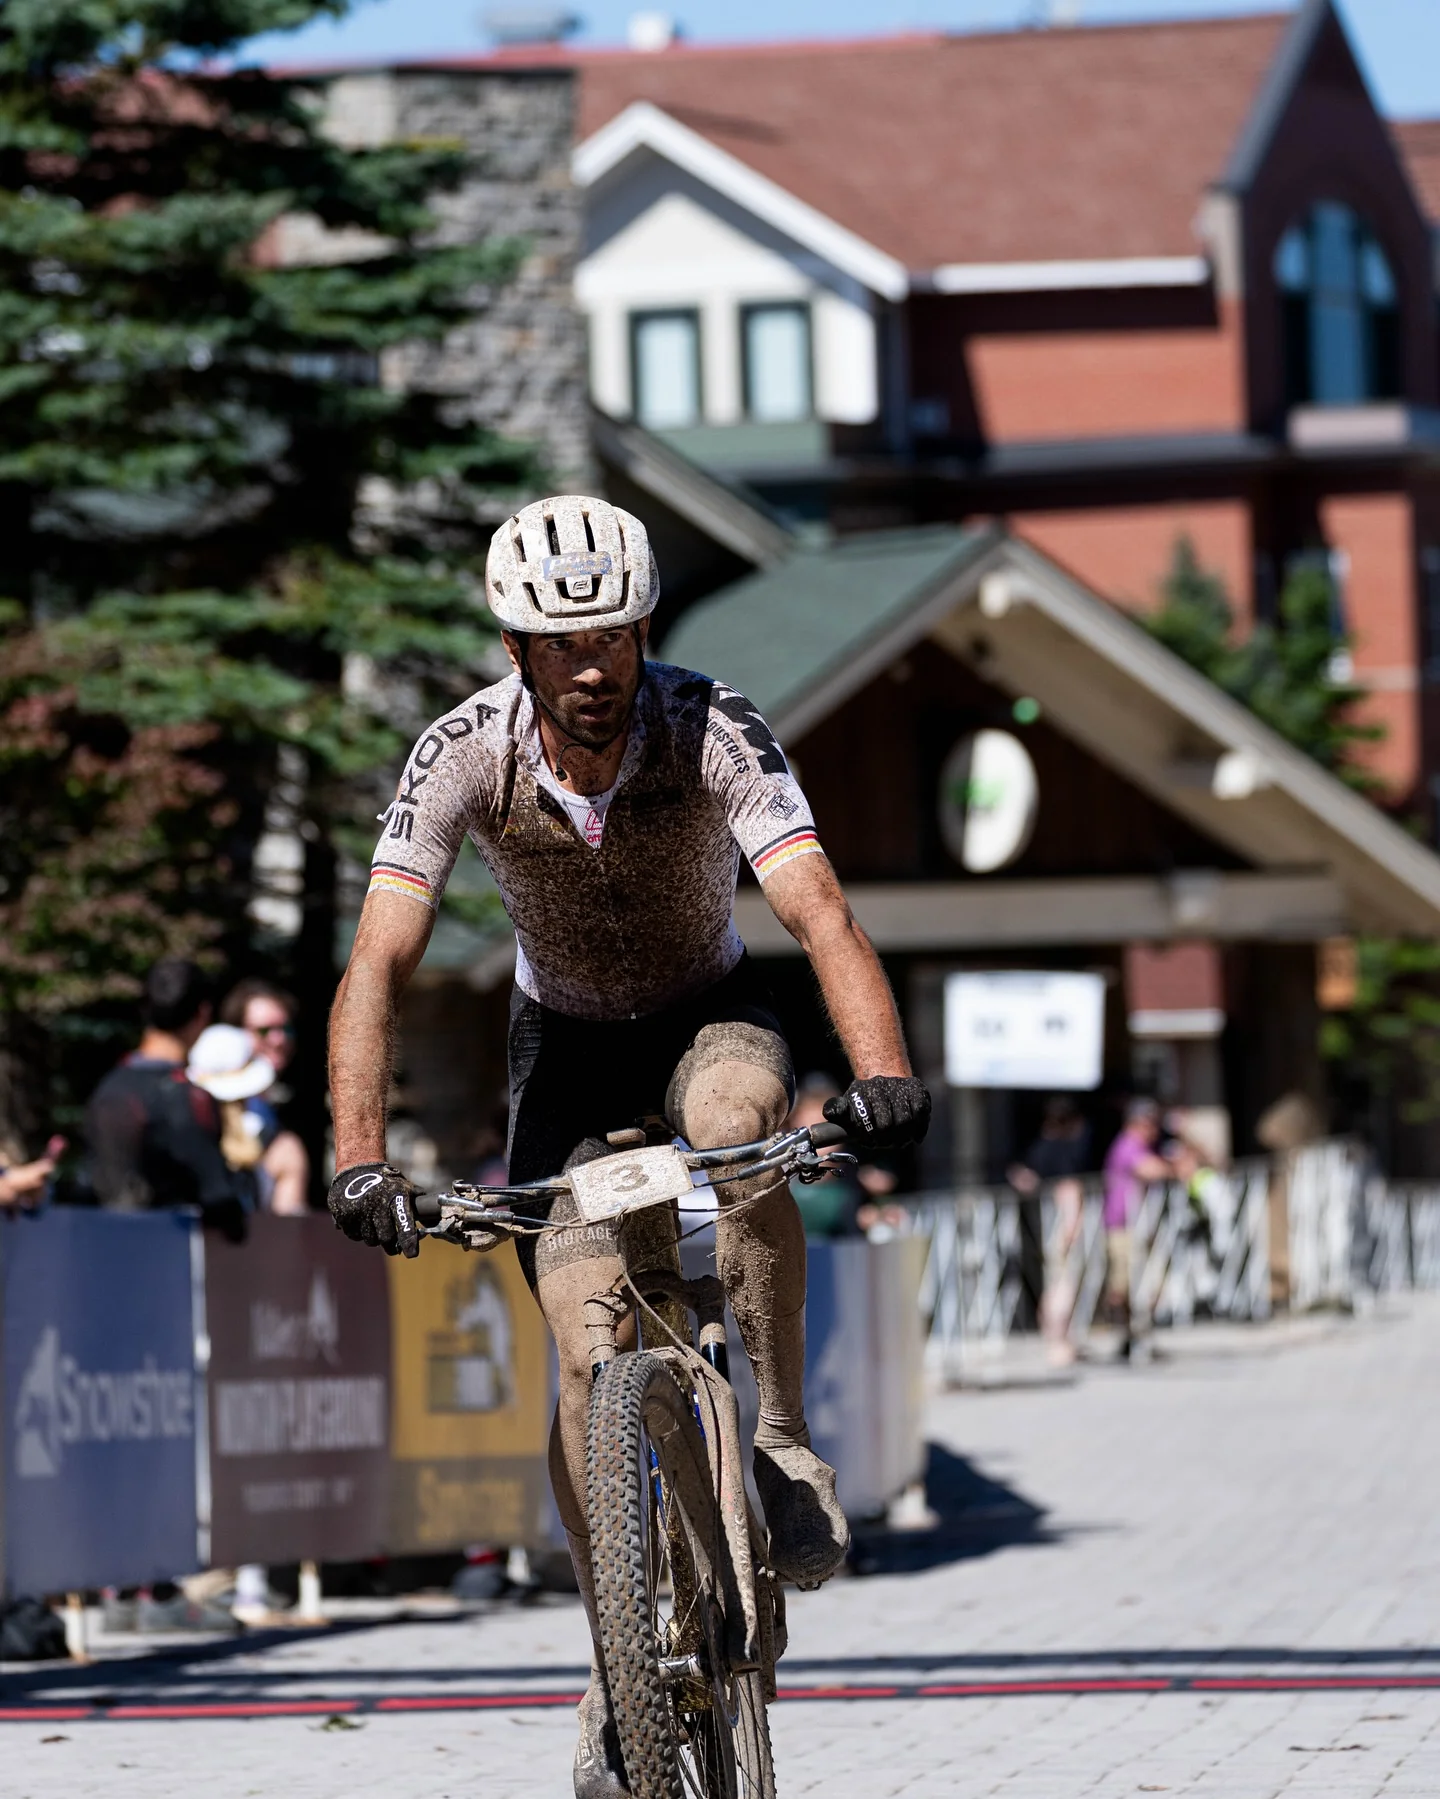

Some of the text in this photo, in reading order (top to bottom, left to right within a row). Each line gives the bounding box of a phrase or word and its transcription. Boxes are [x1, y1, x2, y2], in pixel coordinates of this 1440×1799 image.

[705, 718, 750, 773] DUSTRIES
[851, 1091, 874, 1132] ERGON
[609, 1163, 650, 1192] 3
[395, 1195, 411, 1232] ERGON
